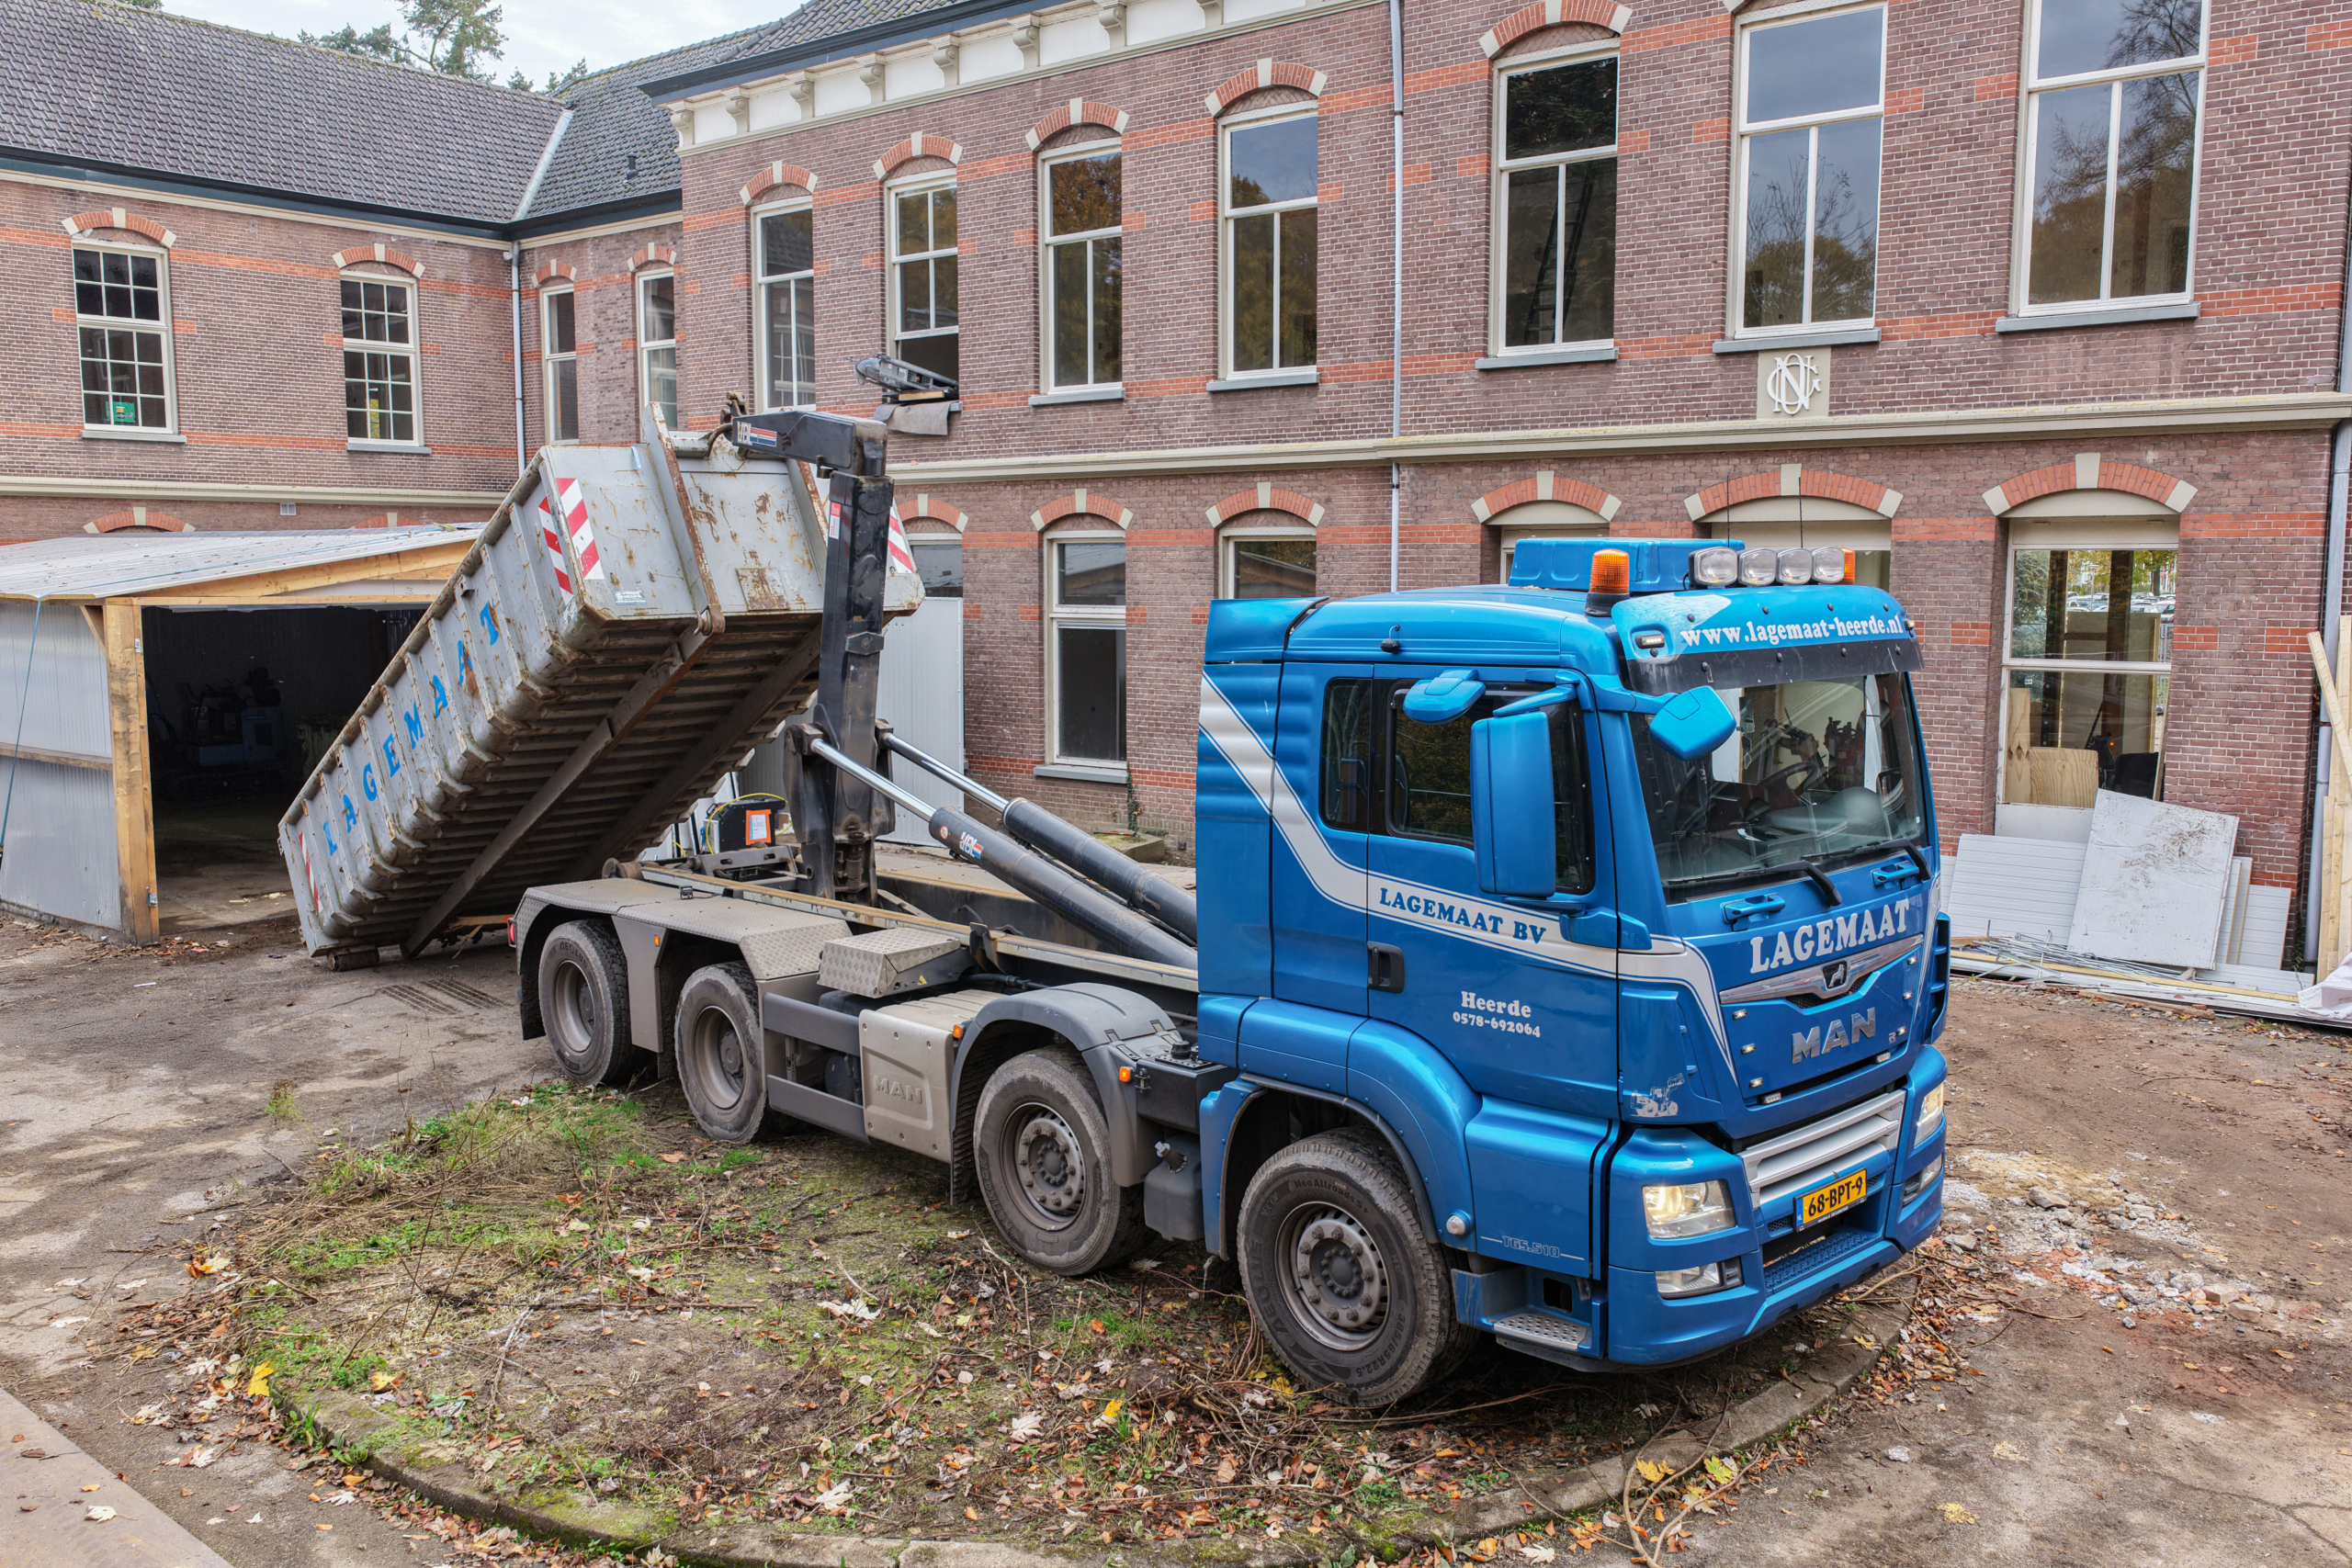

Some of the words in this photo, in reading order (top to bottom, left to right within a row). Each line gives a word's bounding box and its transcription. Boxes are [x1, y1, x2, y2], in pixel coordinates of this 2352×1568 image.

[1680, 615, 1904, 647] www.lagemaat-heerde.nl
[1379, 887, 1503, 934] LAGEMAAT
[1513, 920, 1547, 943] BV
[1749, 898, 1910, 974] LAGEMAAT
[1461, 991, 1532, 1018] Heerde
[1453, 1011, 1541, 1038] 0578-692064
[1792, 1007, 1876, 1065] MAN
[873, 1075, 923, 1104] MAN
[1294, 1179, 1313, 1189] Neo
[1808, 1176, 1863, 1217] 68-BPT-9
[1501, 1235, 1560, 1258] TGS.510
[1355, 1313, 1406, 1378] 385/65R22.5
